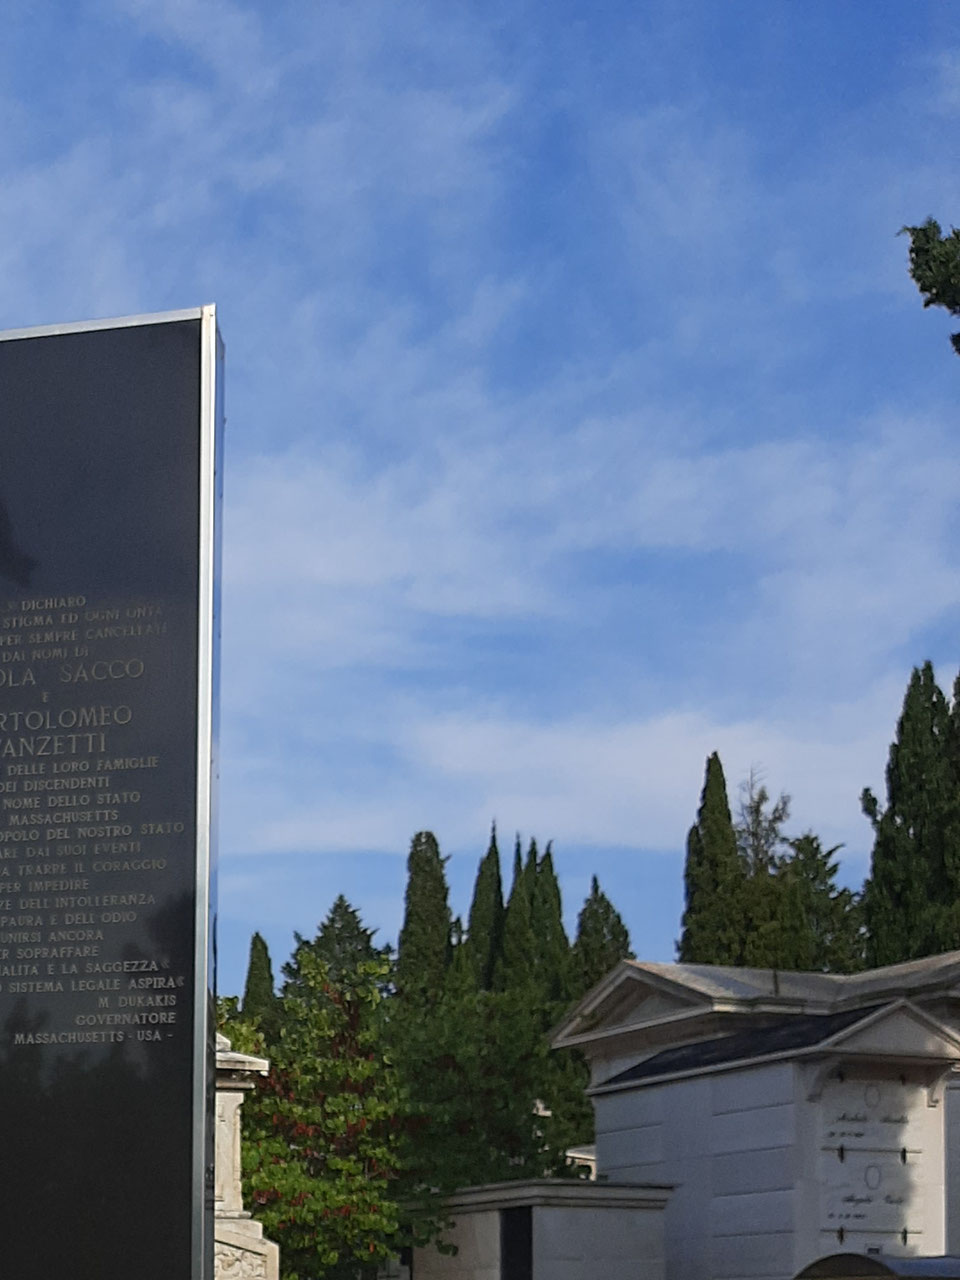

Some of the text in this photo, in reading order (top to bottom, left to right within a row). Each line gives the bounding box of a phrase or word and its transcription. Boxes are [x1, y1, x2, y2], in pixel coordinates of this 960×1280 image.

[21, 596, 86, 611] DICHIARO
[3, 615, 54, 629] STIGMA
[61, 614, 78, 624] ED
[0, 634, 21, 647] PER
[29, 631, 78, 644] SEMPRE
[2, 646, 89, 663] DAI NOMI DI
[60, 658, 145, 683] SACCO
[42, 692, 48, 702] E
[7, 764, 45, 777] DELLE
[53, 761, 89, 774] LORO
[96, 757, 160, 771] FAMIGLIE
[24, 776, 109, 792] DISCENDENTI
[2, 797, 40, 810] NOME
[48, 794, 90, 808] DELLO
[96, 792, 141, 805] STATO
[9, 810, 119, 826] MASSACHUSETTS
[46, 829, 70, 841] DEL
[78, 825, 132, 839] NOSTRO
[141, 822, 184, 835] STATO
[26, 847, 50, 857] DAI
[57, 845, 86, 856] SUOI
[94, 842, 141, 855] EVENTI
[18, 865, 67, 877] TRARRE
[75, 863, 86, 873] IL
[93, 859, 166, 872] CORAGGIO
[0, 879, 89, 893] PER IMPEDIRE
[1, 915, 43, 928] PAURA
[51, 916, 58, 926] E
[0, 932, 41, 944] UNIRSI
[48, 930, 104, 942] ANCORA
[16, 946, 99, 960] SOPRAFFARE
[47, 964, 55, 975] E
[61, 964, 78, 974] LA
[9, 981, 64, 993] SISTEMA
[71, 978, 121, 991] LEGALE
[118, 994, 176, 1008] DUKAKIS
[76, 1012, 176, 1026] GOVERNATORE
[14, 1031, 124, 1045] MASSACHUSETTS
[137, 1031, 162, 1041] USA
